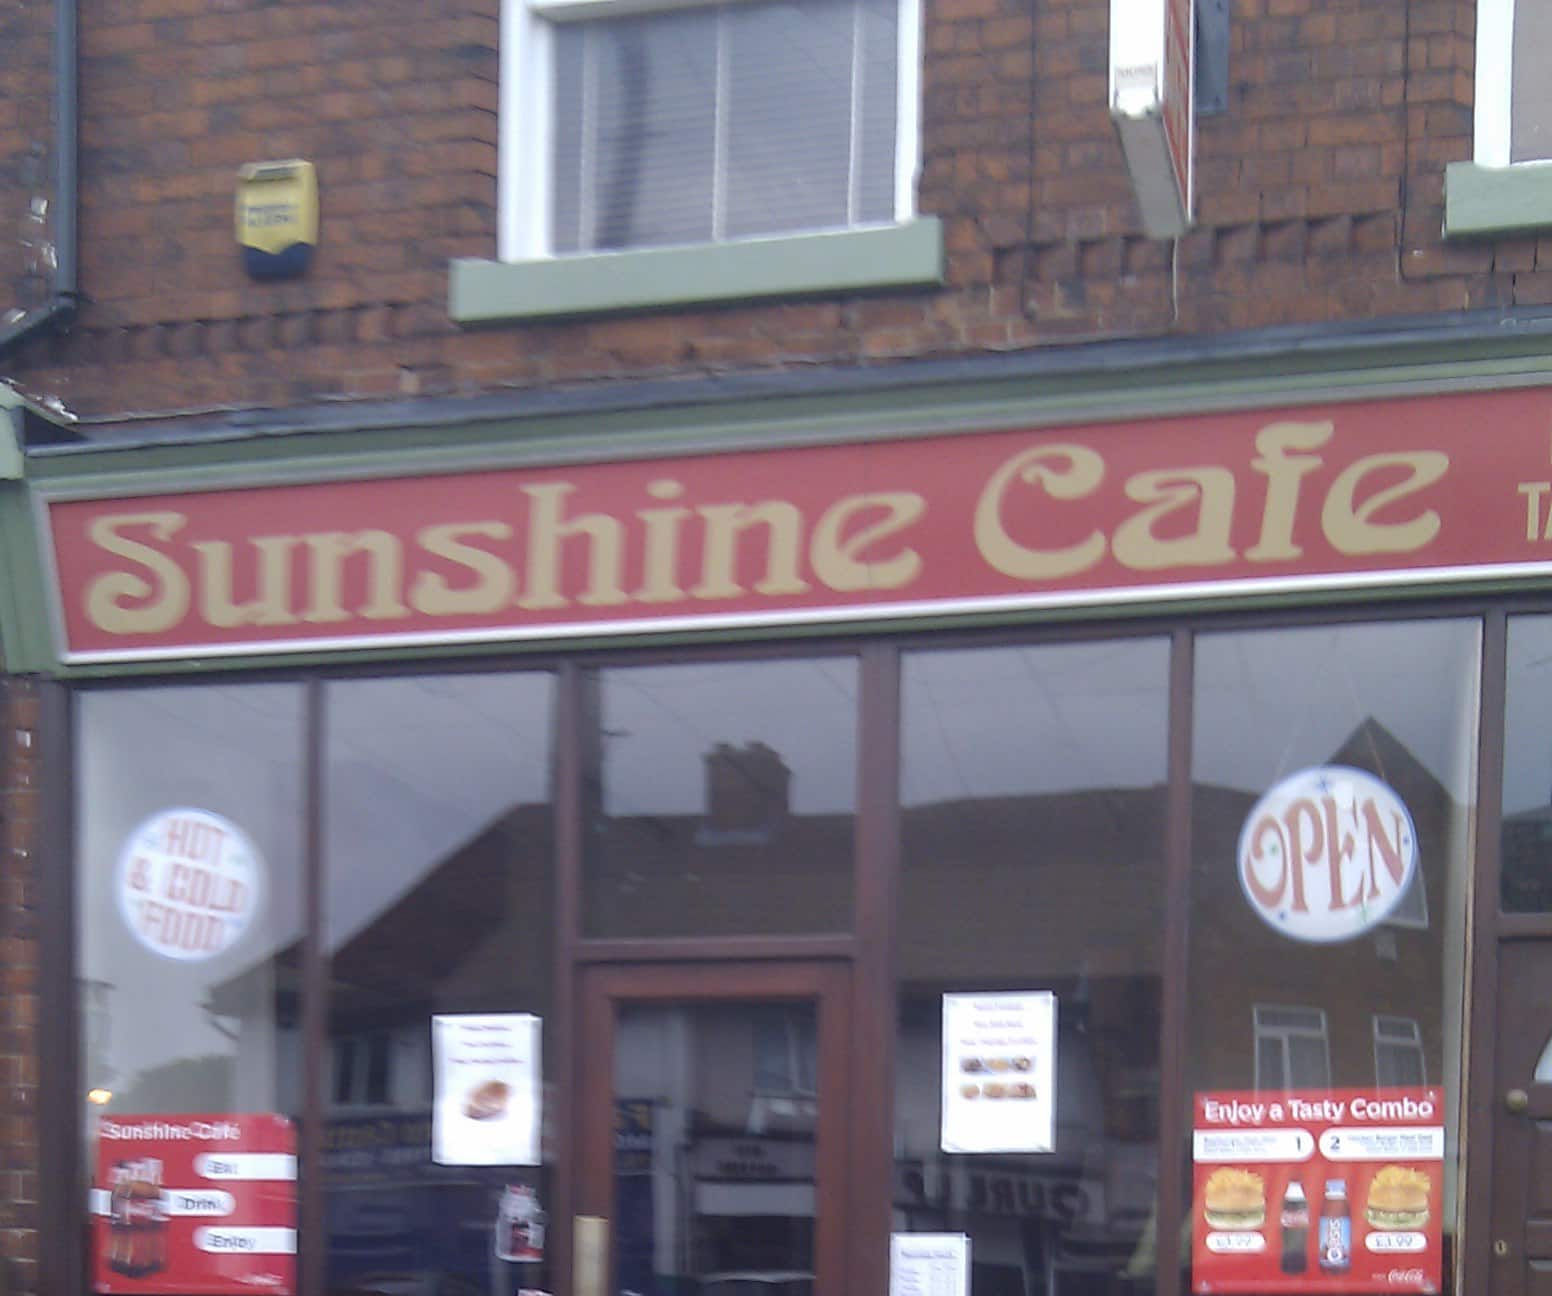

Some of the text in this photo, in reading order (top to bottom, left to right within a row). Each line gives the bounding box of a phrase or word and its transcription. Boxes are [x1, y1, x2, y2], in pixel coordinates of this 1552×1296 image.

[84, 420, 1450, 634] Sunshine Cafe
[165, 817, 226, 868] HOT
[1245, 794, 1405, 914] OPEN
[166, 862, 248, 914] COLD
[142, 898, 226, 952] FOOD
[102, 1121, 192, 1140] Sunshine
[1203, 1096, 1434, 1125] Enjoy a Tasty Combo
[1329, 1135, 1341, 1151] 2
